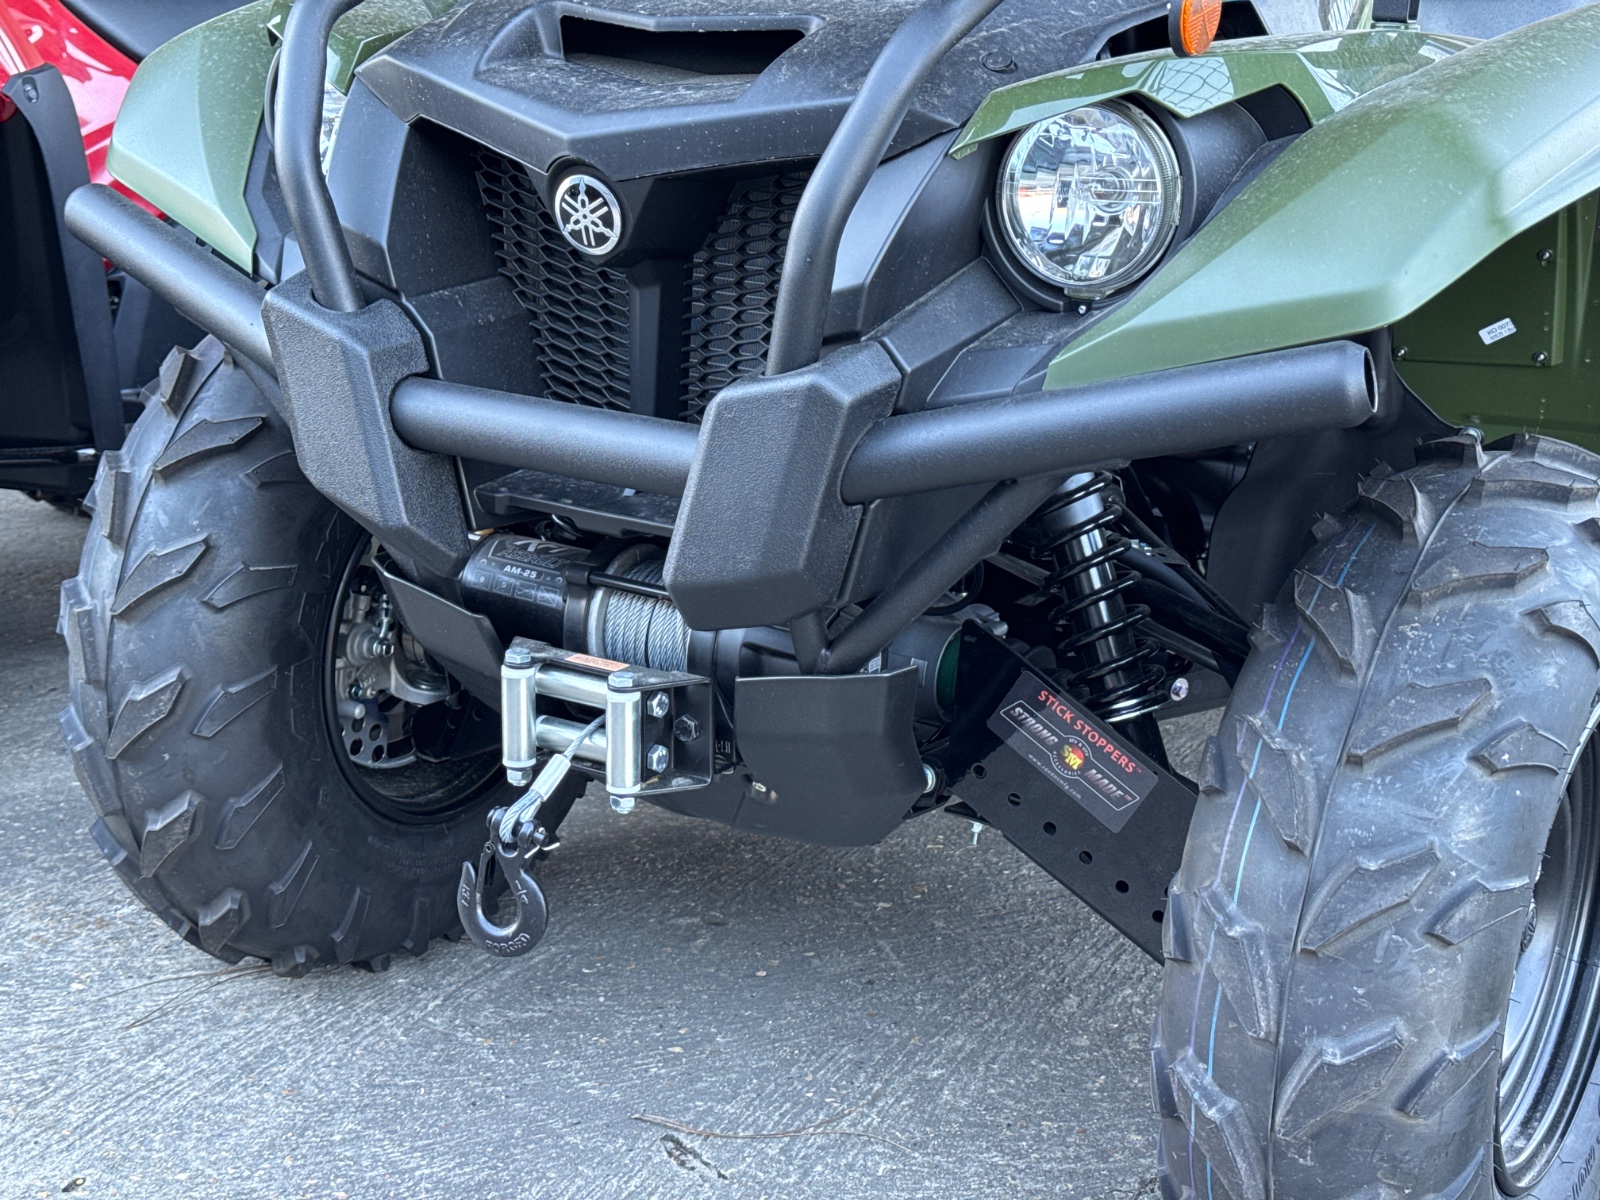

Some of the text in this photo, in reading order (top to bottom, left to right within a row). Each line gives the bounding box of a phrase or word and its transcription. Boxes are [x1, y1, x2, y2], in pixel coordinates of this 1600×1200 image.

[497, 546, 570, 569] ASSAULT
[503, 565, 538, 579] AM-25
[1037, 690, 1076, 724] STICK
[1073, 719, 1137, 773] STOPPERS
[1009, 706, 1059, 746] STRONG
[1084, 768, 1124, 801] MADE
[1052, 750, 1082, 776] ACCESSORIES
[1060, 744, 1083, 770] SM
[485, 932, 531, 954] FORGED
